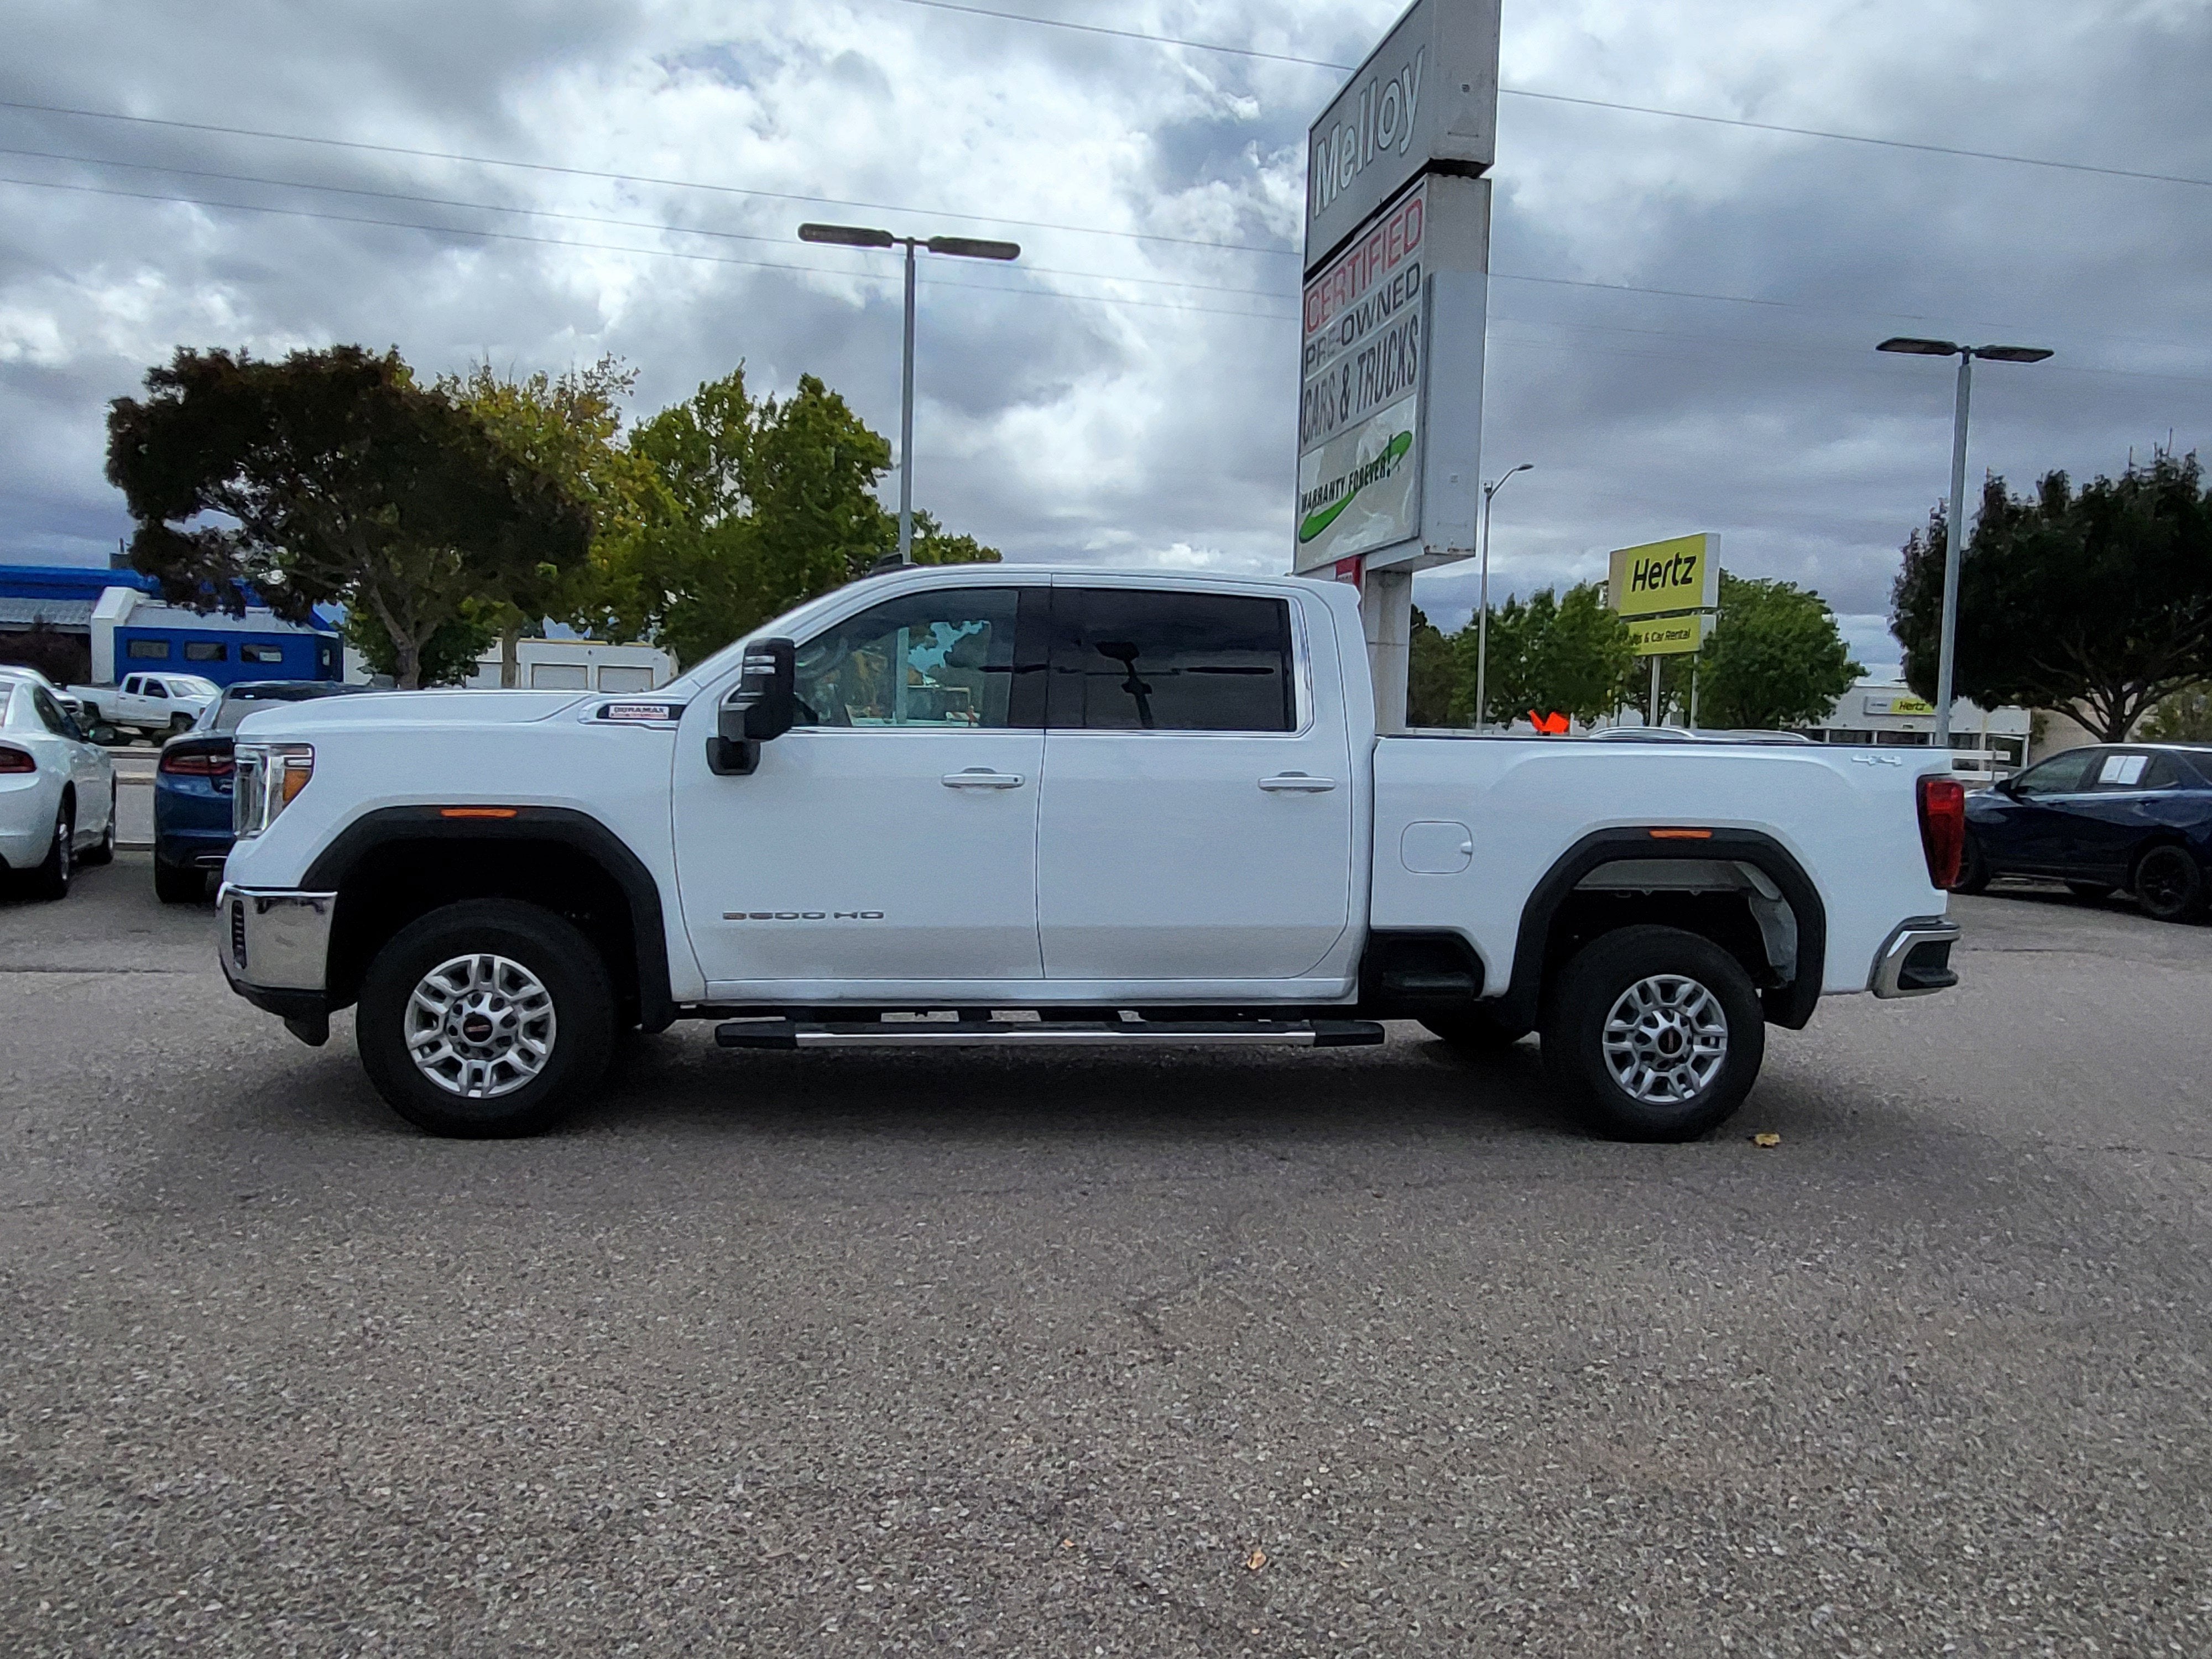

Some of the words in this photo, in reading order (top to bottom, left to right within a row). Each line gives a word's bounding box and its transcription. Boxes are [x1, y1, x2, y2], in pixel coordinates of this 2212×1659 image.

[1314, 44, 1425, 220] Melloy
[1307, 198, 1423, 333] CERTIFIED
[1306, 262, 1420, 374] PRE-OWNED
[1303, 370, 1335, 444] CARS
[1339, 362, 1350, 424] &
[1356, 314, 1418, 414] TRUCKS
[1301, 476, 1346, 514] WARRANTY
[1631, 552, 1697, 592] Hertz
[1651, 632, 1665, 643] Car
[1665, 627, 1691, 640] Rental
[1899, 701, 1926, 711] Hertz
